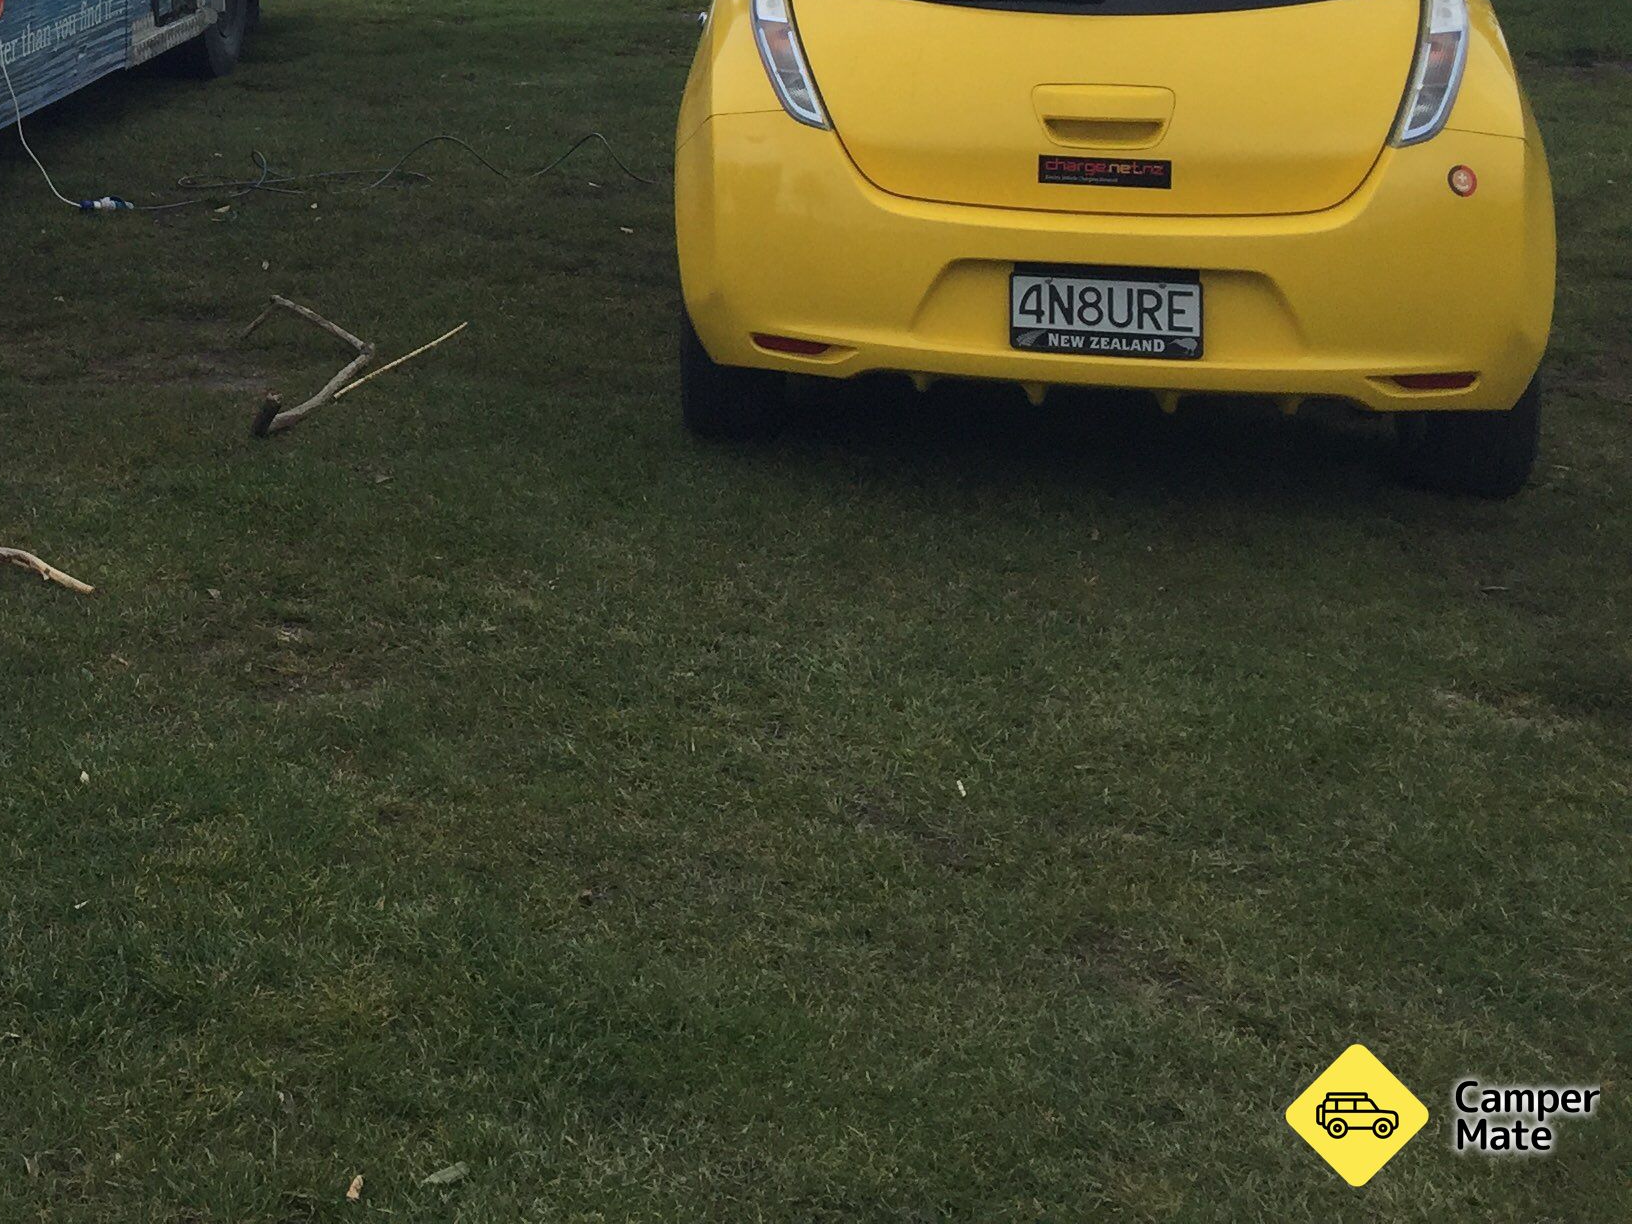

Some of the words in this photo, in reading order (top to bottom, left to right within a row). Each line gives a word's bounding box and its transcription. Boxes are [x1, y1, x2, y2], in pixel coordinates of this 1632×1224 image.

[21, 24, 52, 57] than
[54, 15, 78, 51] you
[1018, 283, 1195, 333] 4N8URE
[1047, 332, 1086, 348] NEW
[1089, 336, 1166, 353] ZEALAND
